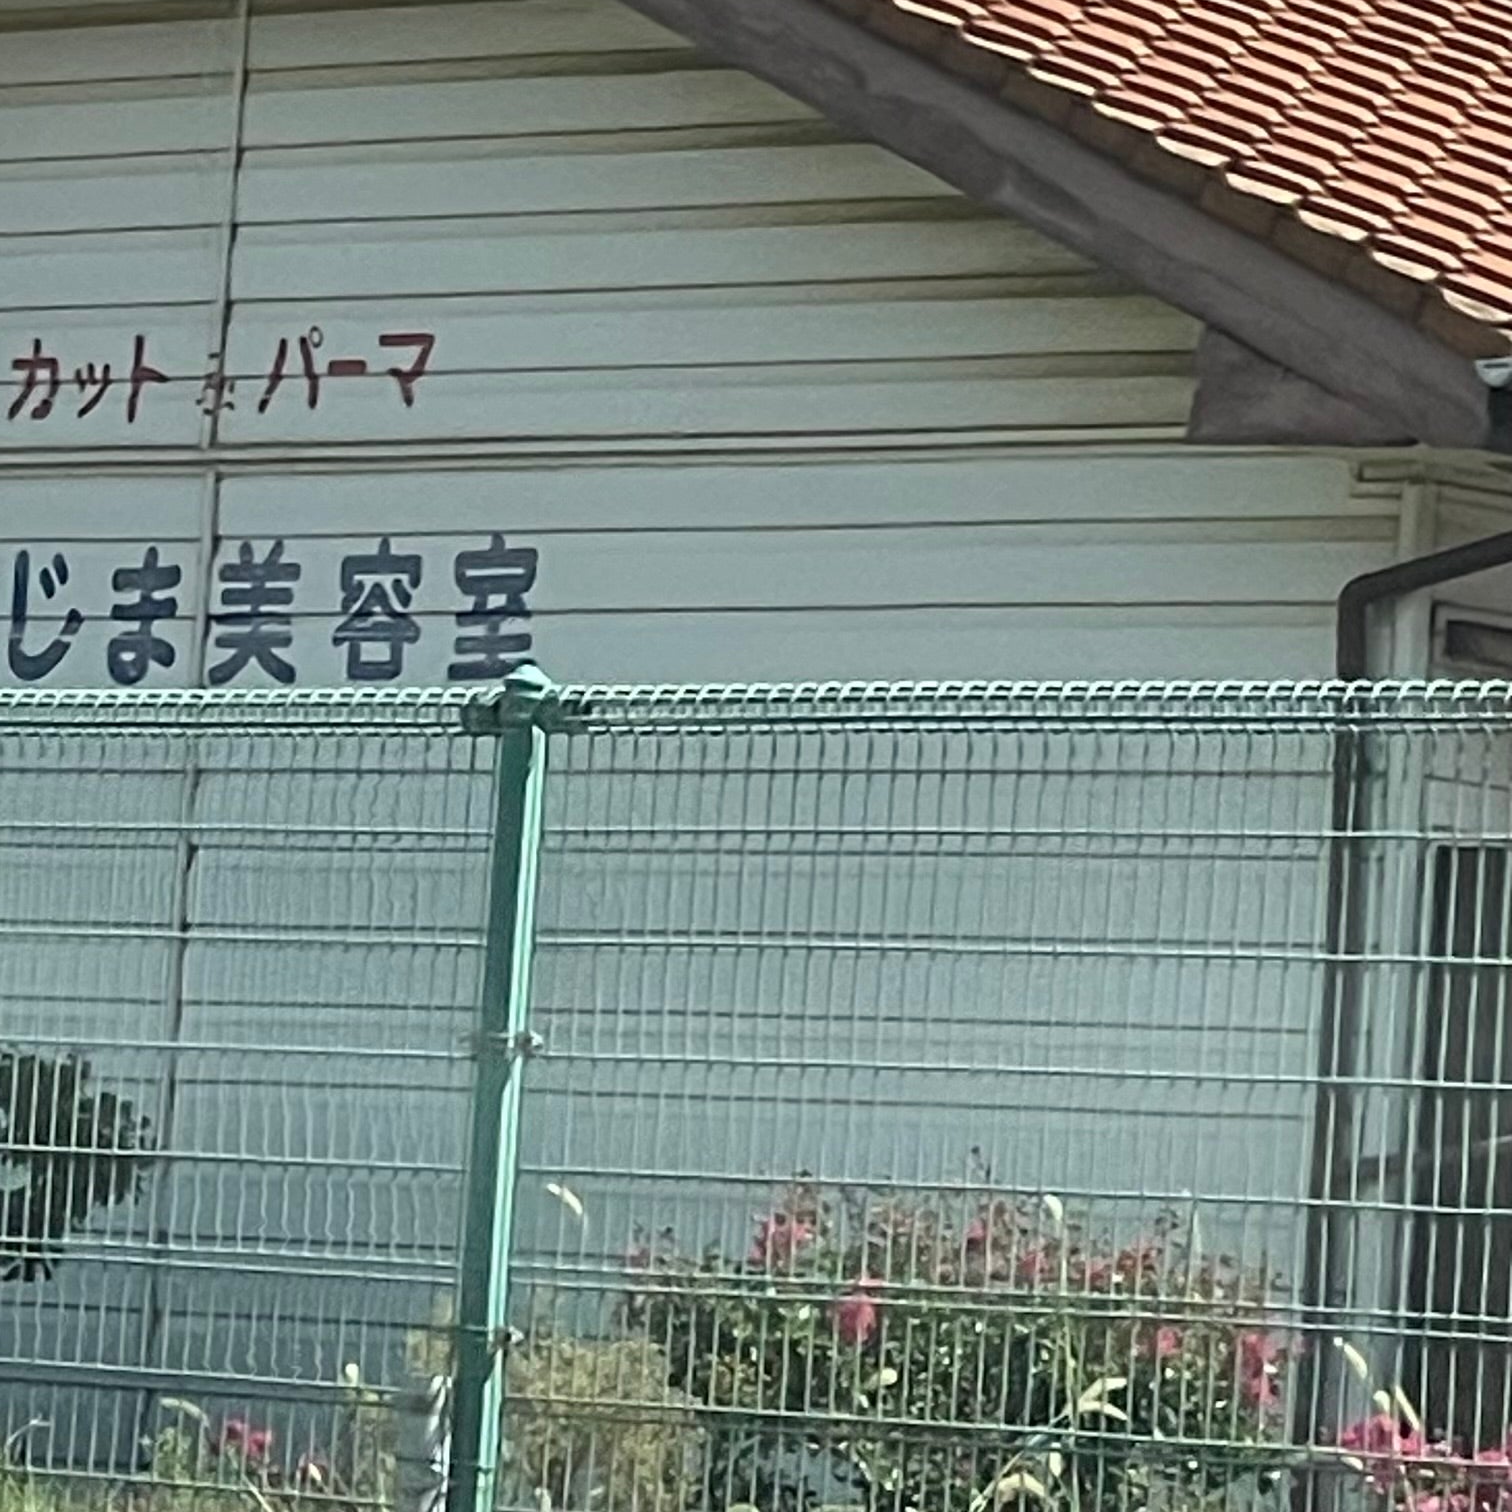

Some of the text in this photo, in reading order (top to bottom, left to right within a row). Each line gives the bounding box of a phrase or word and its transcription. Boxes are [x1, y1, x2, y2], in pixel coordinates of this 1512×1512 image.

[7, 326, 434, 422] カット パーマ
